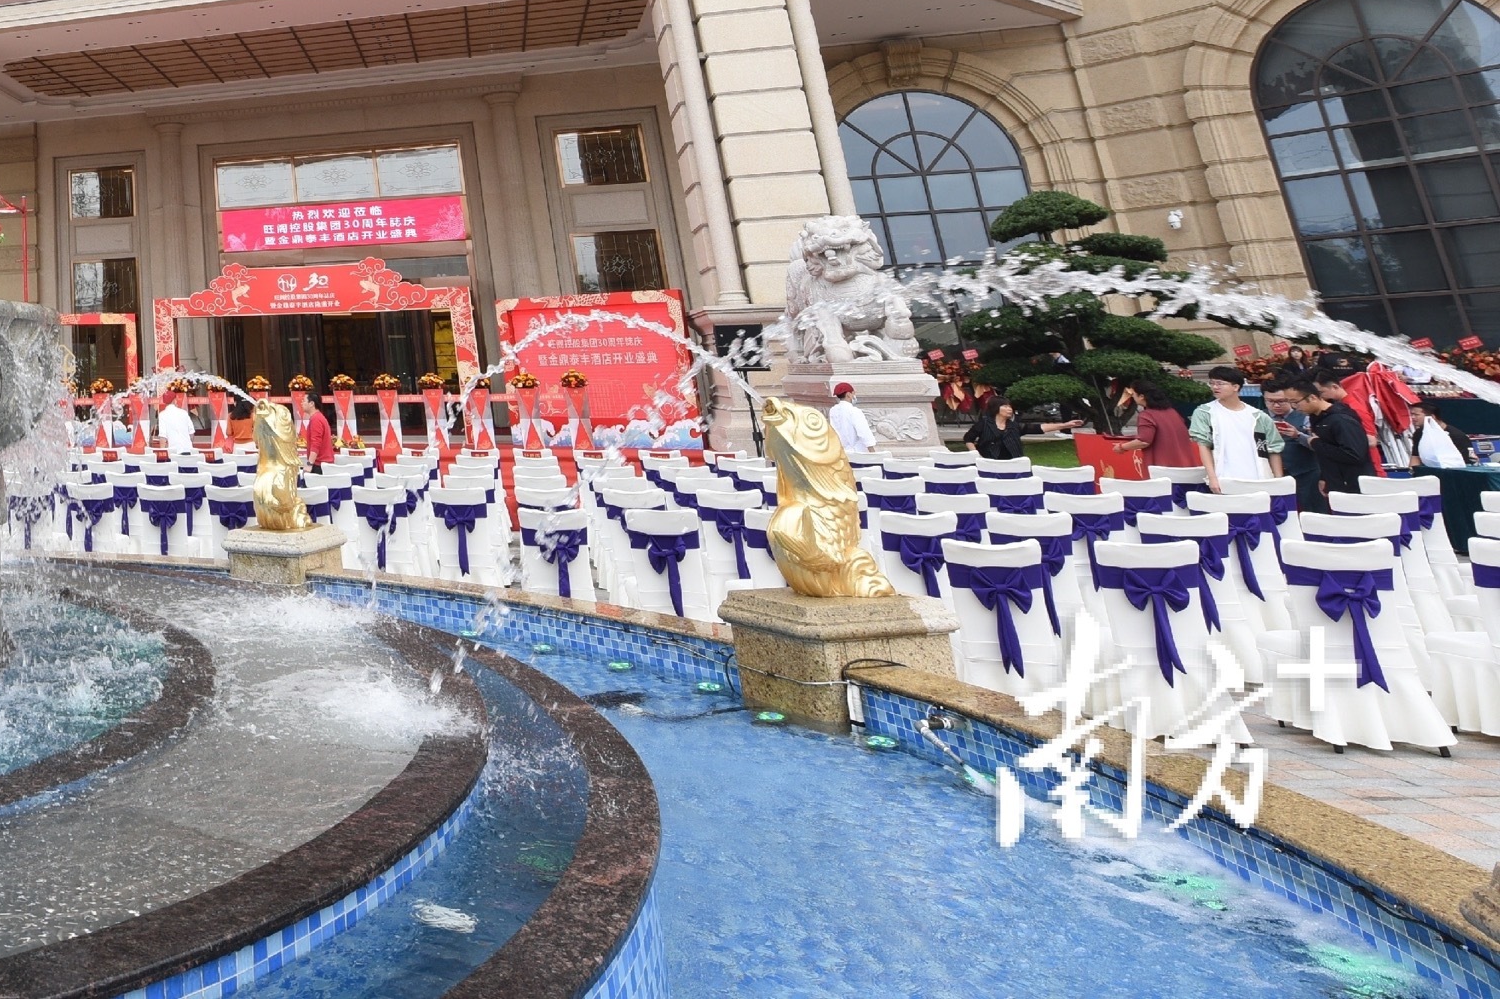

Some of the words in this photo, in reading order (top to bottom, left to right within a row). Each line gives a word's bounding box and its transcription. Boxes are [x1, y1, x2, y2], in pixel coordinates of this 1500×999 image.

[291, 205, 384, 221] 热烈欢迎莅临
[264, 229, 419, 246] 暨金鼎泰丰酒店开业盛典
[537, 350, 659, 367] 暨金鼎泰丰酒店开业盛典
